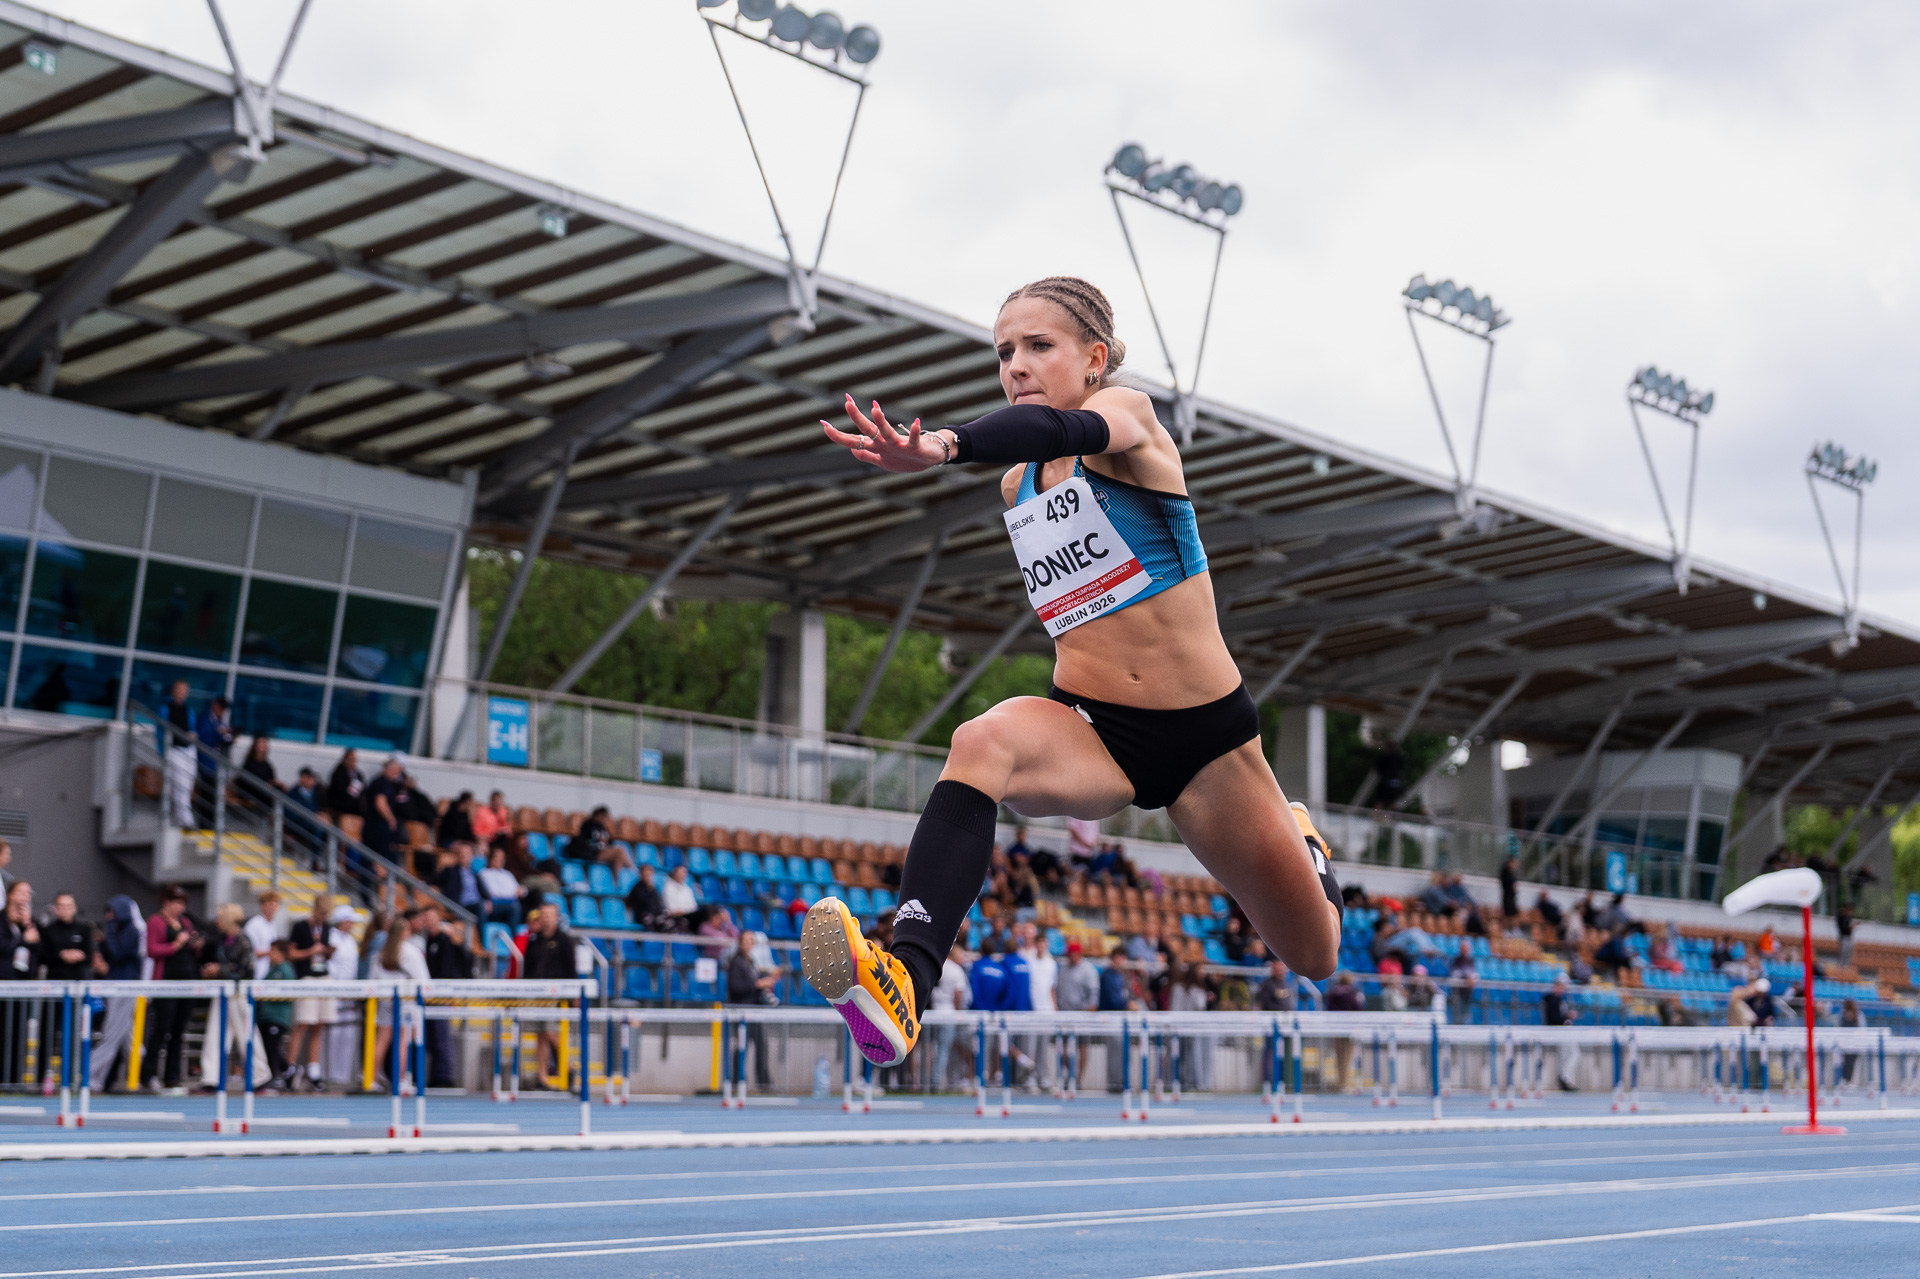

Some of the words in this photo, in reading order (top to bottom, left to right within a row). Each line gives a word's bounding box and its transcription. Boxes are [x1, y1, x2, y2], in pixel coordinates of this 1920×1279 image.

[1046, 488, 1080, 524] 439
[1022, 532, 1110, 594] DONIEC
[1099, 563, 1132, 584] MŁODZIEŻY
[1054, 608, 1088, 630] LUBLIN
[1088, 594, 1116, 614] 2026
[1058, 596, 1086, 614] SPORTACH
[892, 910, 933, 927] adidas
[868, 951, 914, 1039] NITRO
